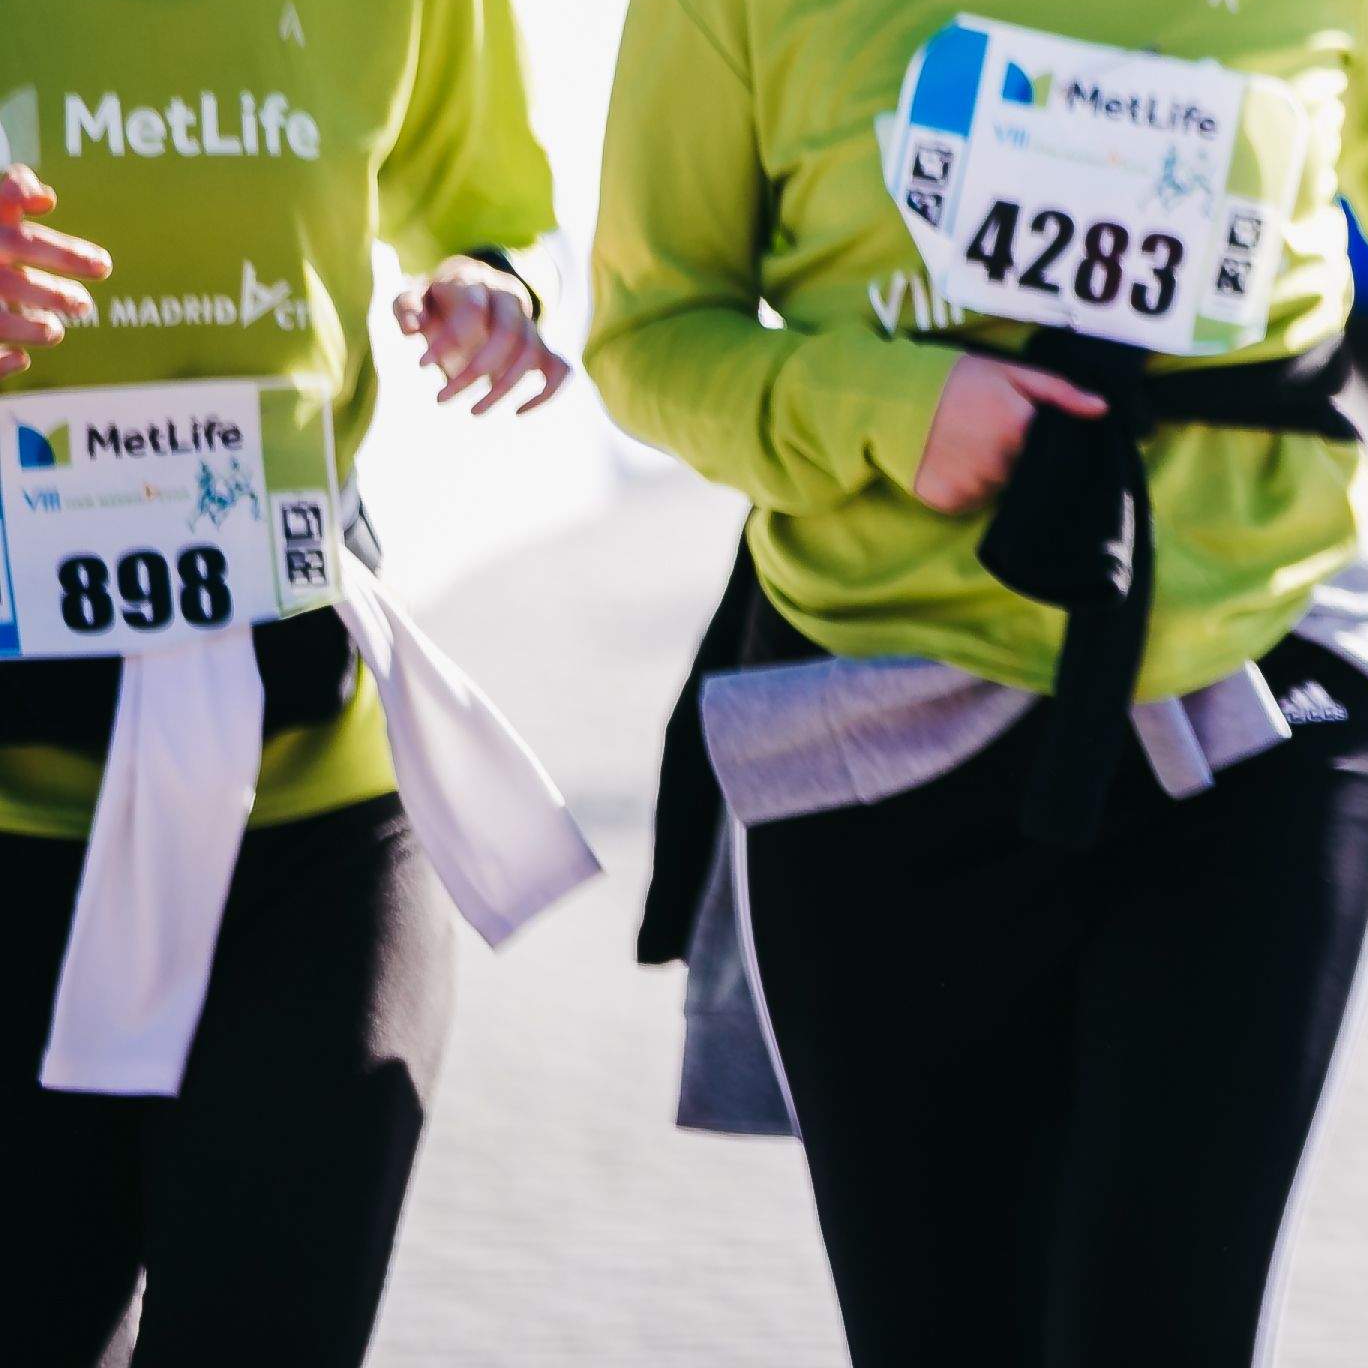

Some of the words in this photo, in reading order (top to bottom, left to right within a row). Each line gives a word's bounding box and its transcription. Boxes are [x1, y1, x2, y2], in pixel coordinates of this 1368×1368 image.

[63, 90, 321, 159] MetLife
[1064, 78, 1218, 138] MetLife
[966, 200, 1184, 314] 4283
[110, 294, 238, 328] MADRID
[86, 415, 244, 461] MetLife
[58, 546, 235, 632] 898
